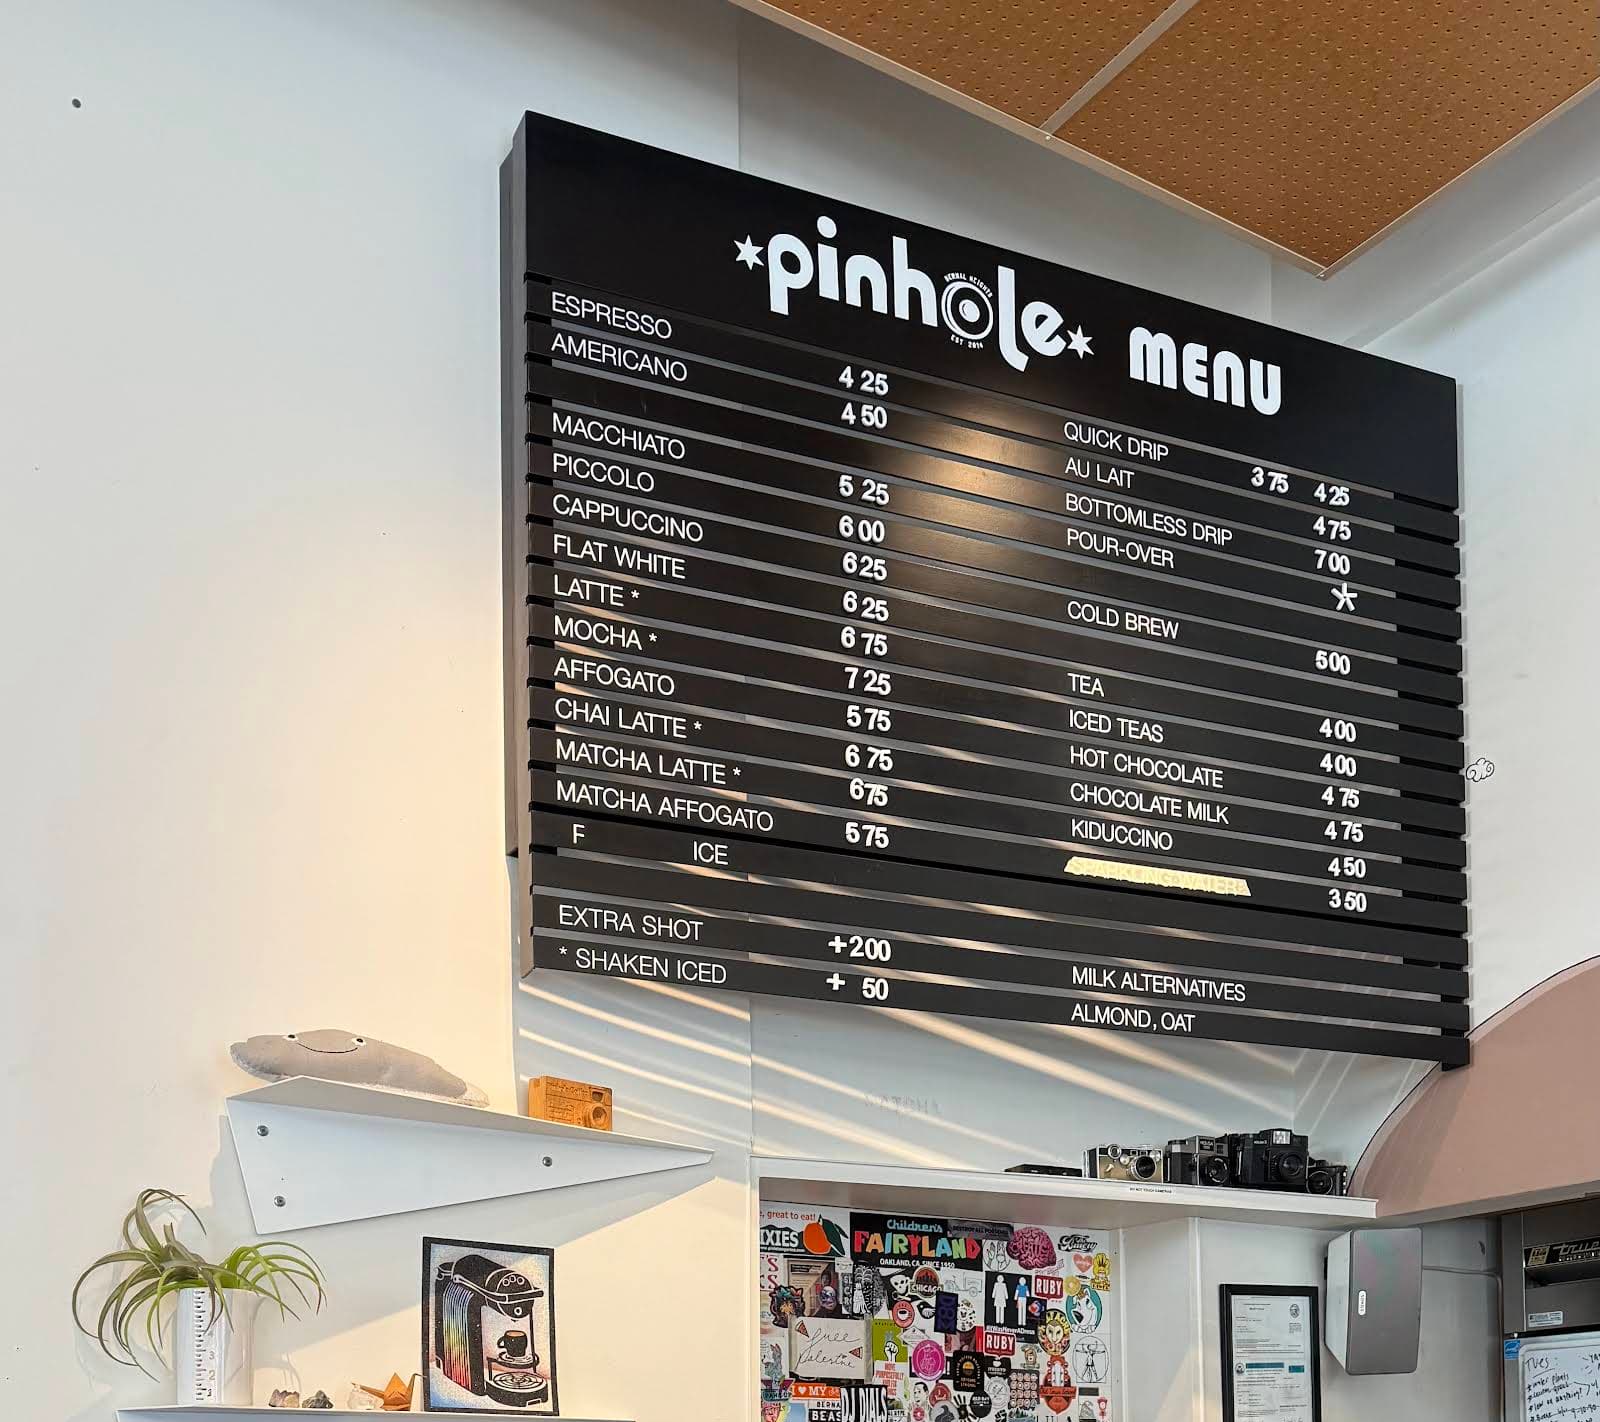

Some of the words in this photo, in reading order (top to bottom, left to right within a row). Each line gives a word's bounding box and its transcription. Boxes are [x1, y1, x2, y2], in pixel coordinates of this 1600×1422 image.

[552, 291, 672, 339] ESPRESSO
[551, 332, 688, 382] AMERICANO
[1129, 326, 1282, 416] MENU
[552, 412, 686, 460] MACCHIATO
[1063, 421, 1123, 452] QUICK
[1127, 436, 1169, 462] DRIP
[553, 452, 655, 493] PICCOLO
[1064, 456, 1090, 479] AU
[1096, 463, 1135, 489] LAIT
[552, 493, 704, 542] CAPPUCCINO
[1065, 492, 1187, 537] BOTTOMLESS
[1192, 522, 1233, 546] DRIP
[553, 533, 609, 563] FLAT
[613, 545, 686, 580] WHITE
[1067, 527, 1174, 569] POUR-OVER
[554, 574, 625, 607] LATTE
[554, 614, 643, 651] MOCHA
[1067, 600, 1120, 627] COLD
[1125, 611, 1179, 640] BREW
[553, 656, 675, 699] AFFOGATO
[1067, 672, 1105, 698] TEA
[554, 697, 610, 726] CHAI
[618, 707, 687, 739] LATTE
[1069, 708, 1112, 734] ICED
[1116, 717, 1164, 743] TEAS
[556, 738, 653, 774] MATCHA
[658, 754, 726, 785] LATTE
[1070, 745, 1110, 769] HOT
[1113, 753, 1224, 789] CHOCOLATE
[556, 779, 653, 815] MATCHA
[657, 796, 774, 832] AFFOGATO
[1070, 782, 1183, 818] CHOCOLATE
[1187, 800, 1229, 825] MILK
[693, 840, 729, 866] ICE
[1071, 818, 1173, 851] KIDUCCINO
[558, 904, 636, 934] EXTRA
[641, 914, 704, 941] SHOT
[575, 947, 669, 978] SHAKEN
[677, 959, 727, 984] ICED
[1072, 965, 1117, 989] MILK
[1120, 971, 1246, 1002] ALTERNATIVES
[1070, 1003, 1157, 1031] ALMOND,
[1160, 1011, 1196, 1033] OAT
[767, 1211, 788, 1220] great
[790, 1212, 799, 1220] to
[800, 1212, 816, 1221] eat!
[887, 1218, 944, 1233] Children's
[854, 1230, 982, 1260] FAIRYLAND
[1036, 1280, 1064, 1296] RUBY
